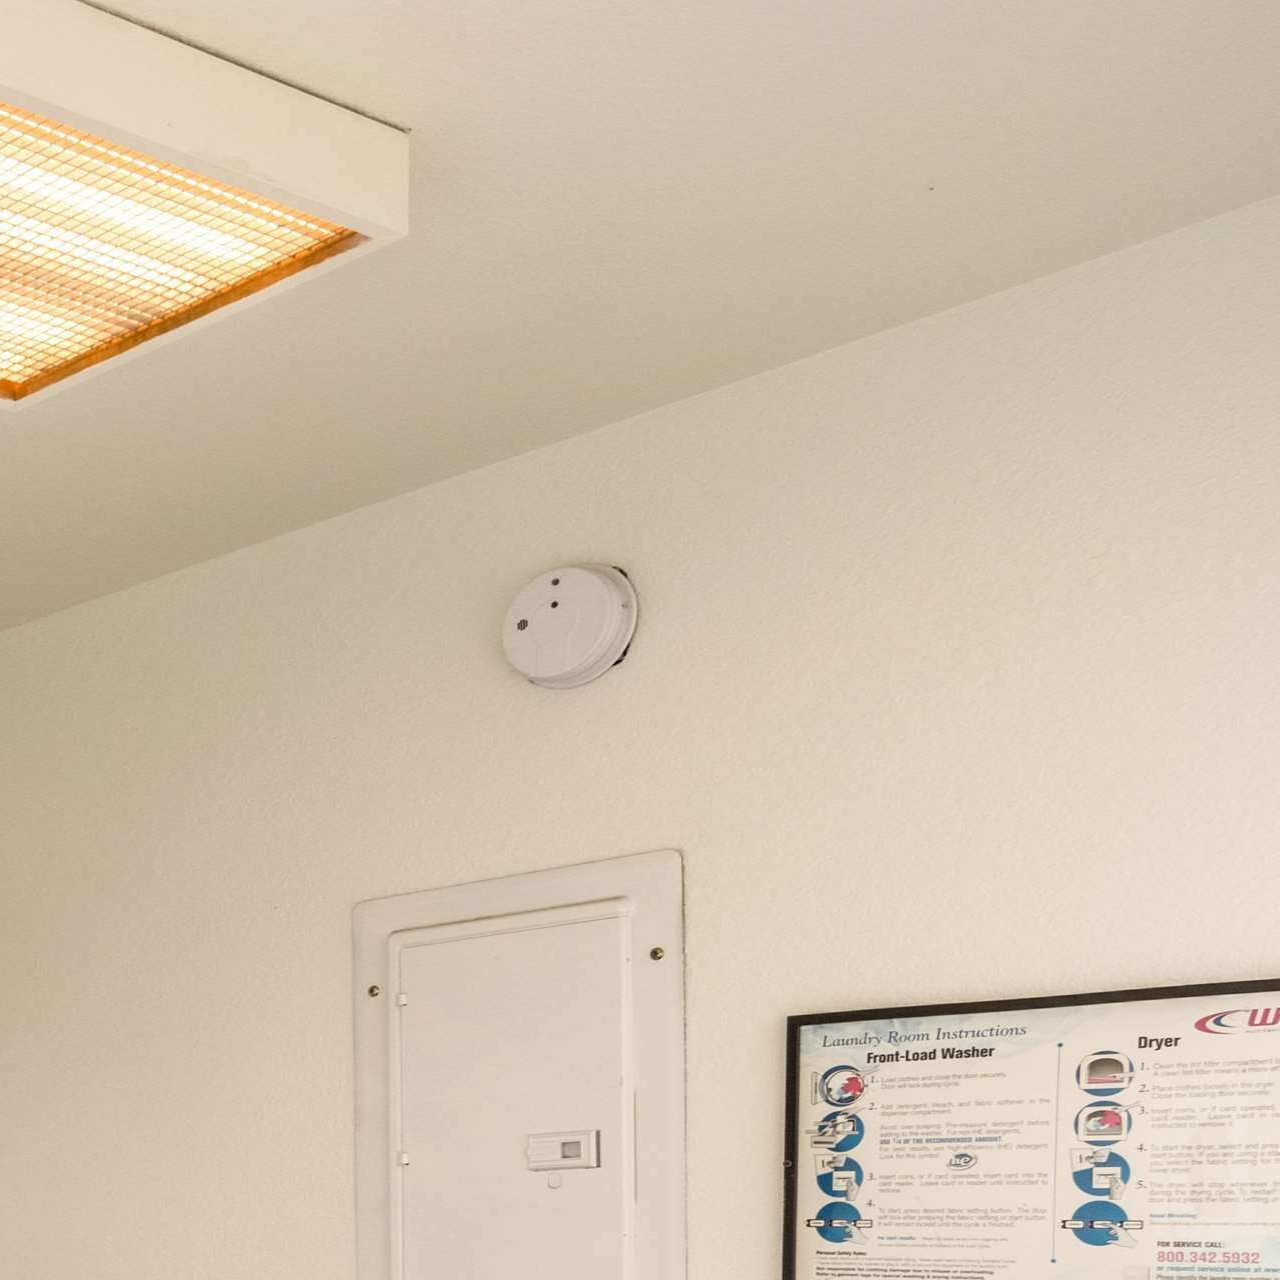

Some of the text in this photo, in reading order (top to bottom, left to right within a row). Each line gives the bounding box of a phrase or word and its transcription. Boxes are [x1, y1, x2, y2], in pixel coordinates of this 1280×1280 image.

[822, 1025, 1028, 1048] Laundry Room Instructions
[1138, 1036, 1182, 1051] Dryer
[867, 1046, 996, 1063] Front-Load Washer
[1157, 1251, 1260, 1264] 800.342.5932
